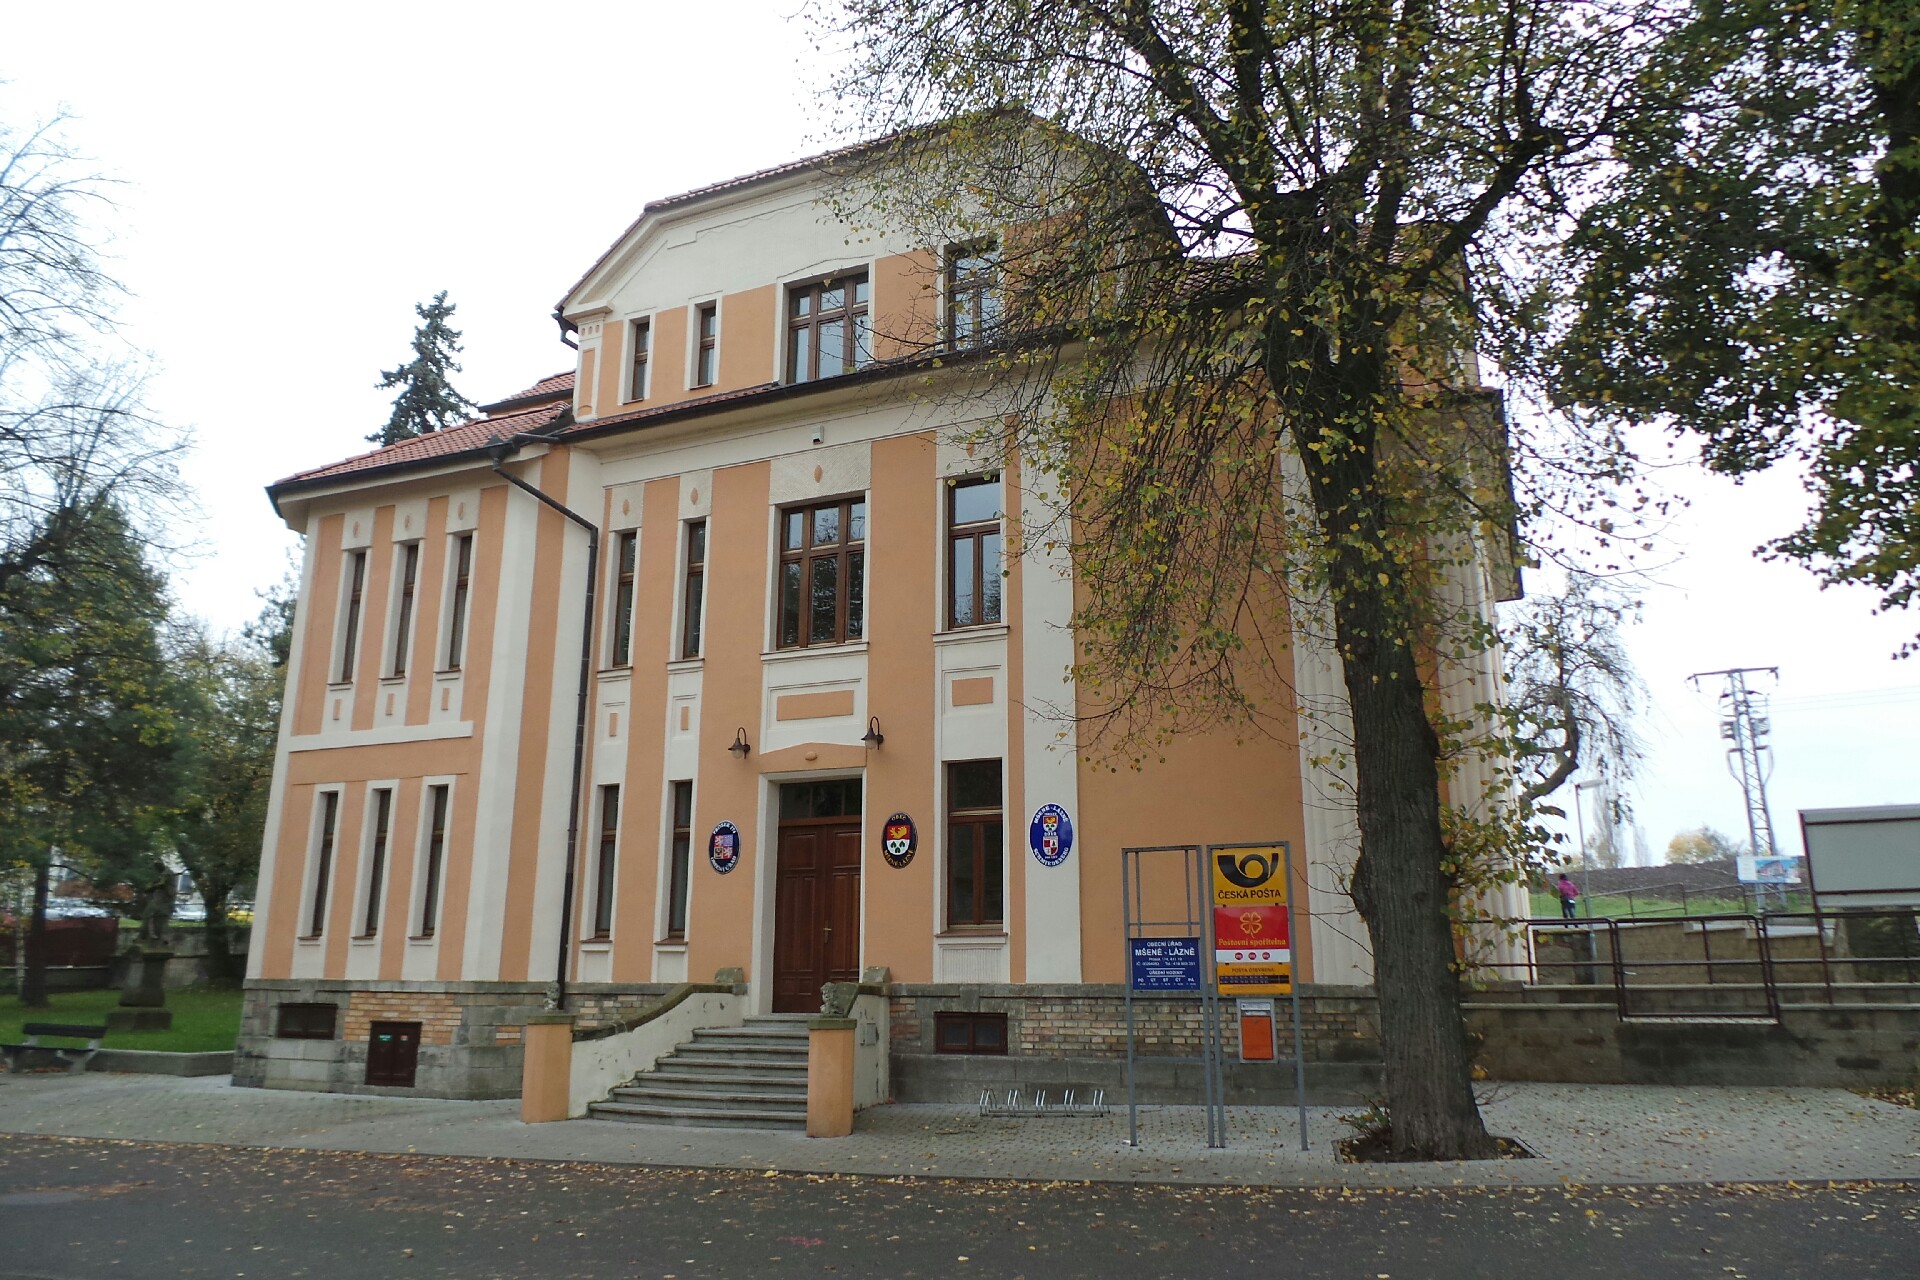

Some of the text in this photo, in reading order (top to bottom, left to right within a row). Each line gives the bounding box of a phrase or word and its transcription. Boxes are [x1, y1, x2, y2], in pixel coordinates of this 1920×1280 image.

[1034, 847, 1069, 866] SCHMIEDEBERG
[1218, 888, 1281, 899] ČESKÁ POŠTA
[1218, 938, 1286, 947] Poštovní spořitelna
[1135, 947, 1163, 956] MŠENÉ
[1168, 947, 1195, 956] LÁZNĚ
